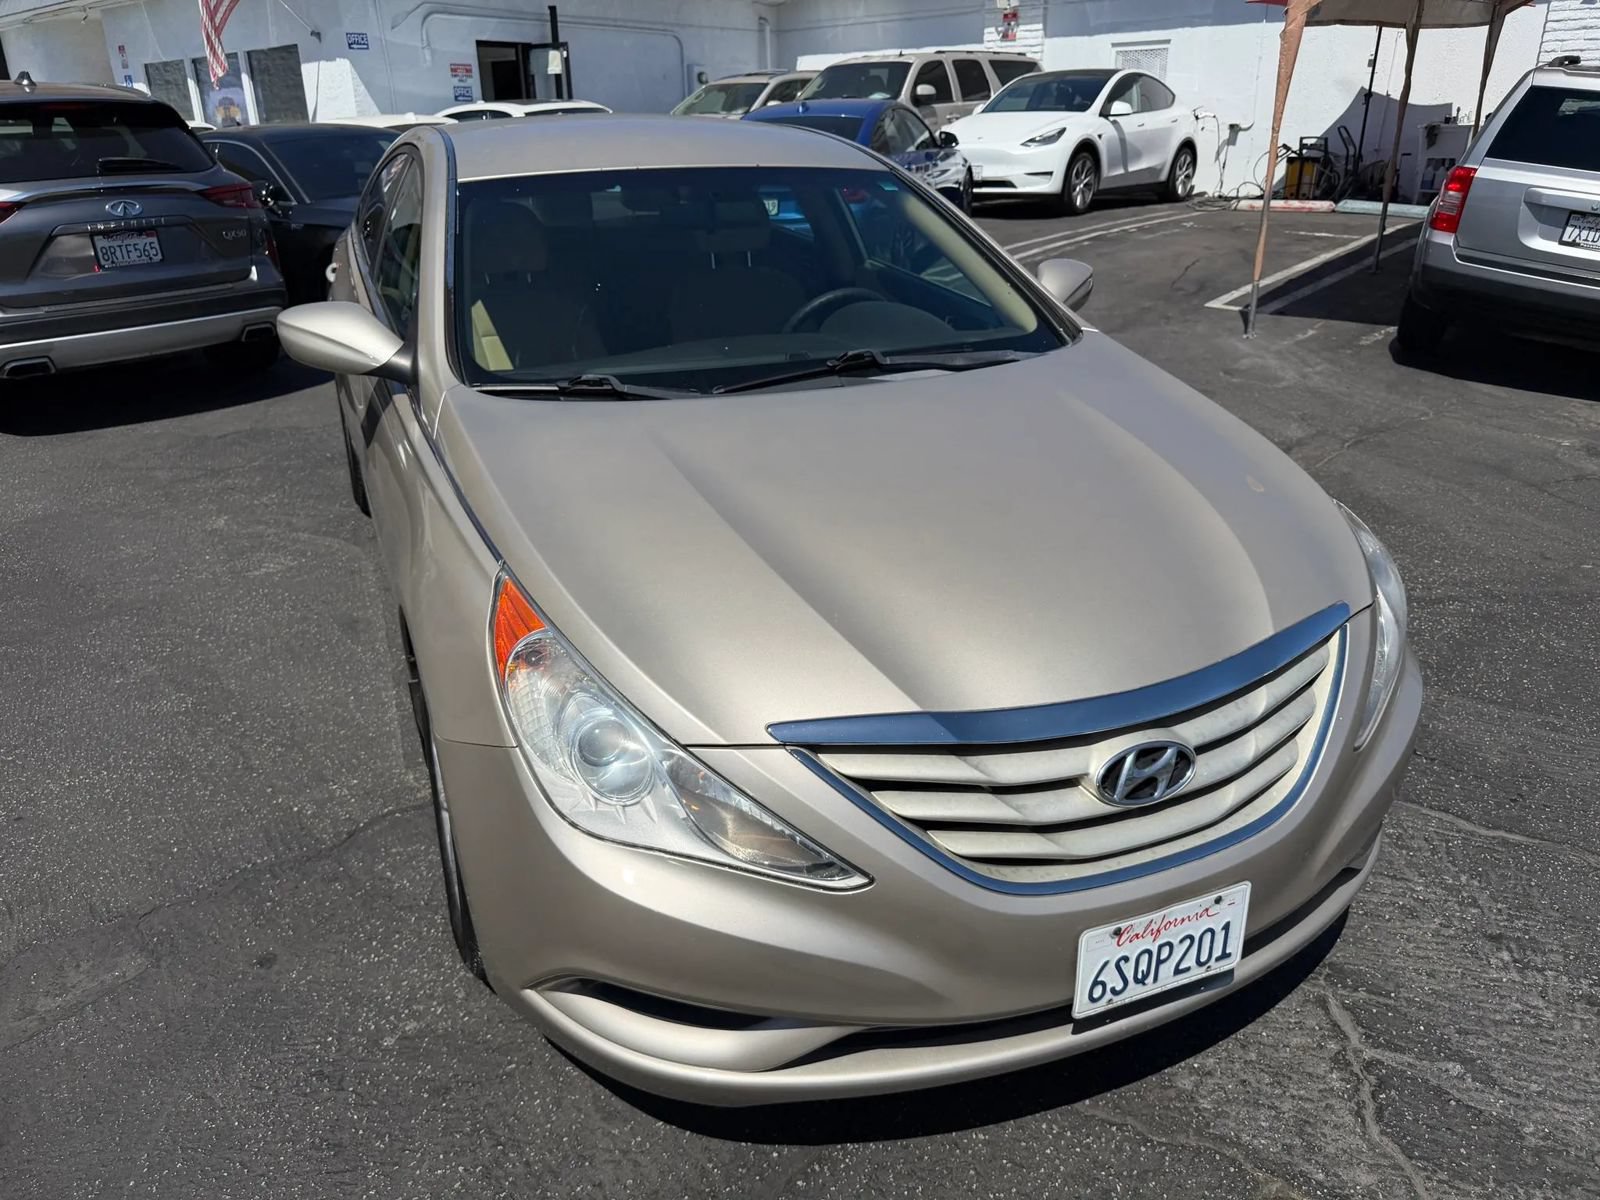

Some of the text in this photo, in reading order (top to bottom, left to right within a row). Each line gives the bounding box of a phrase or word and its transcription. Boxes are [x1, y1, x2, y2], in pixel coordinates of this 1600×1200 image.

[347, 34, 368, 44] OFFICE
[455, 87, 473, 96] OFFICE
[100, 241, 159, 262] 8RTF565
[1116, 907, 1220, 947] California
[1088, 920, 1232, 1003] 6SQP201
